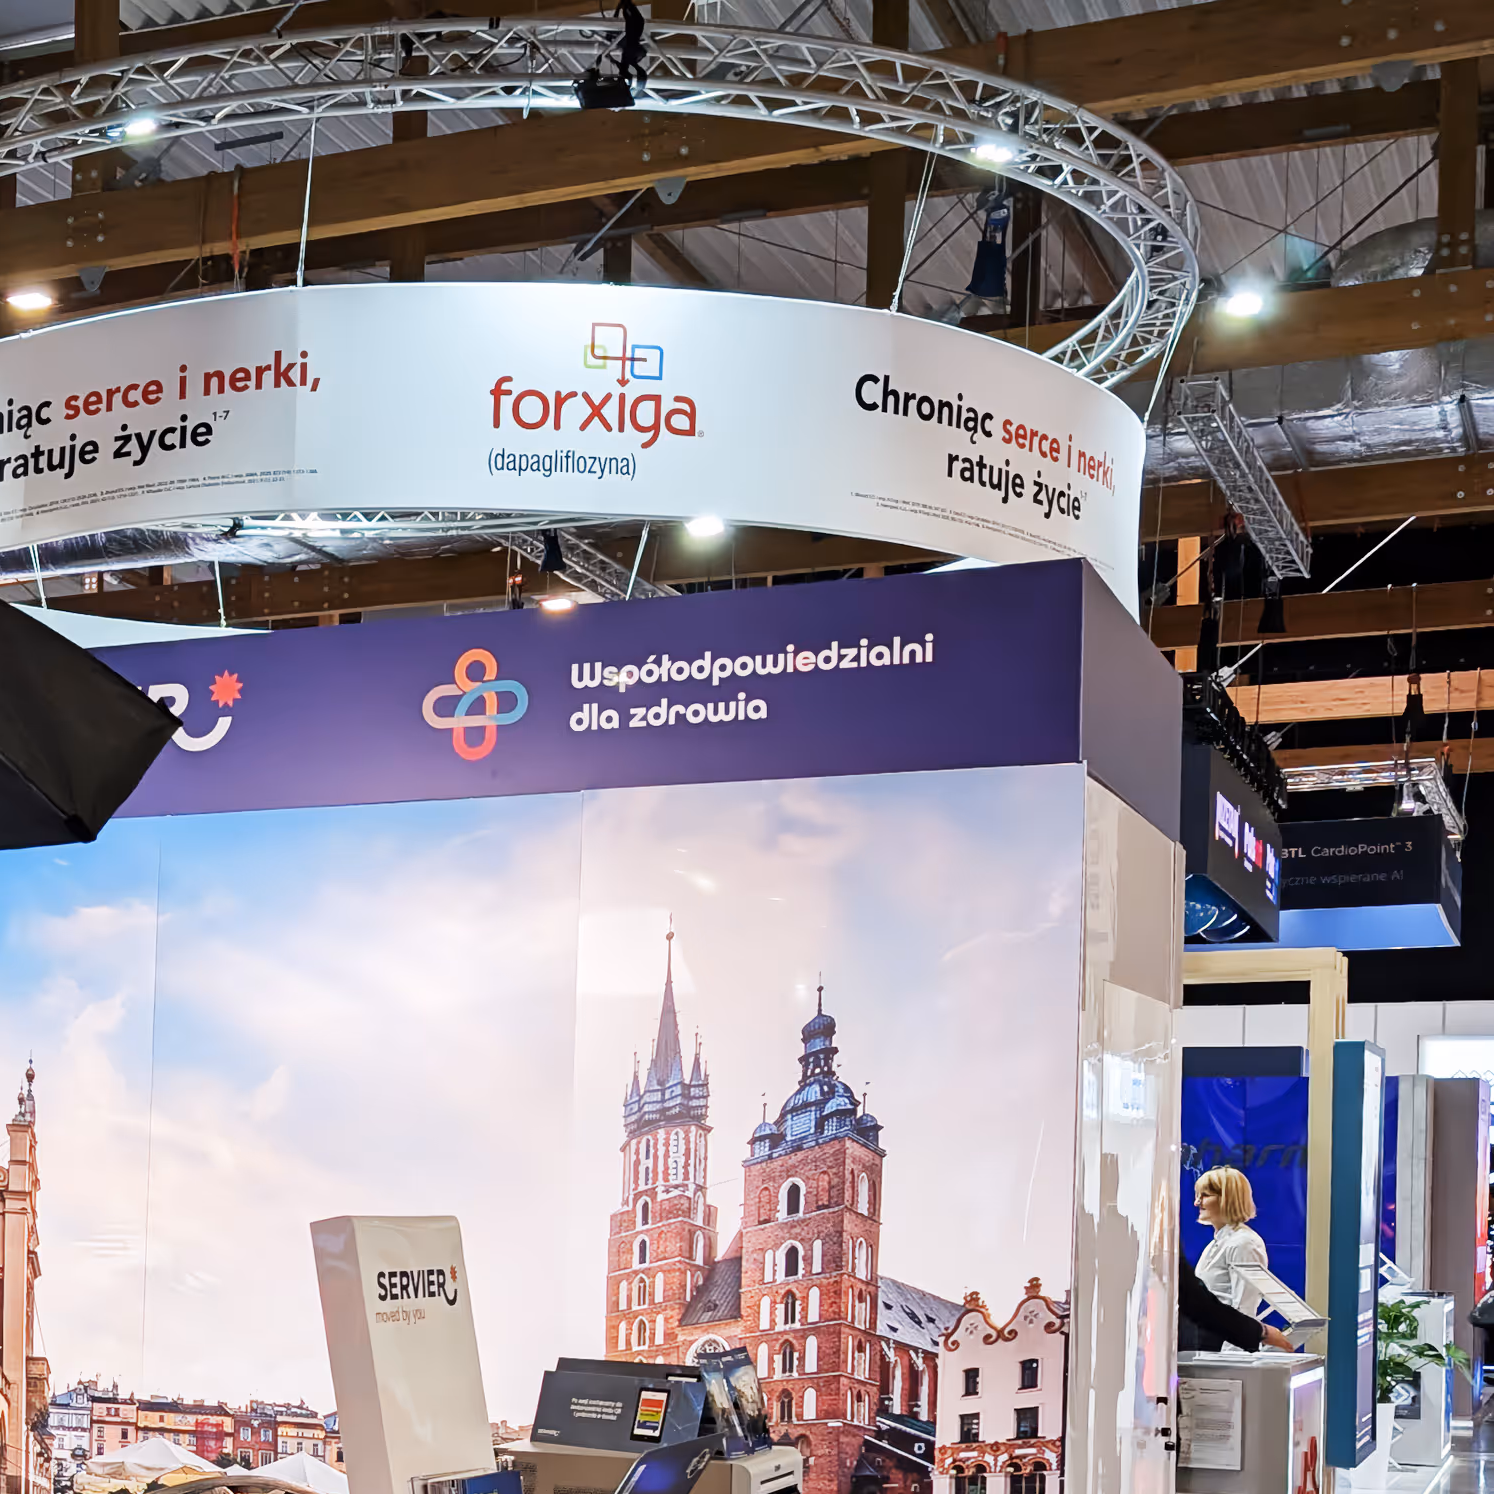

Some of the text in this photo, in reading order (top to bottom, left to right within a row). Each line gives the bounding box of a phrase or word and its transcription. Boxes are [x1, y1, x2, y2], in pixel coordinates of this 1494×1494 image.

[63, 376, 164, 420] serce
[178, 363, 188, 401] i
[202, 350, 322, 398] nerki,
[854, 373, 994, 445] Chroniąc
[1001, 418, 1061, 463] serce
[1066, 433, 1073, 469] i
[487, 447, 637, 481] (dapagliflozyna)
[947, 452, 1025, 504] ratuje
[570, 633, 936, 694] Współodpowiedzialni
[569, 692, 768, 731] dla zdrowia
[377, 1268, 458, 1306] SERVIER
[375, 1306, 401, 1324] moved
[412, 1308, 426, 1325] you
